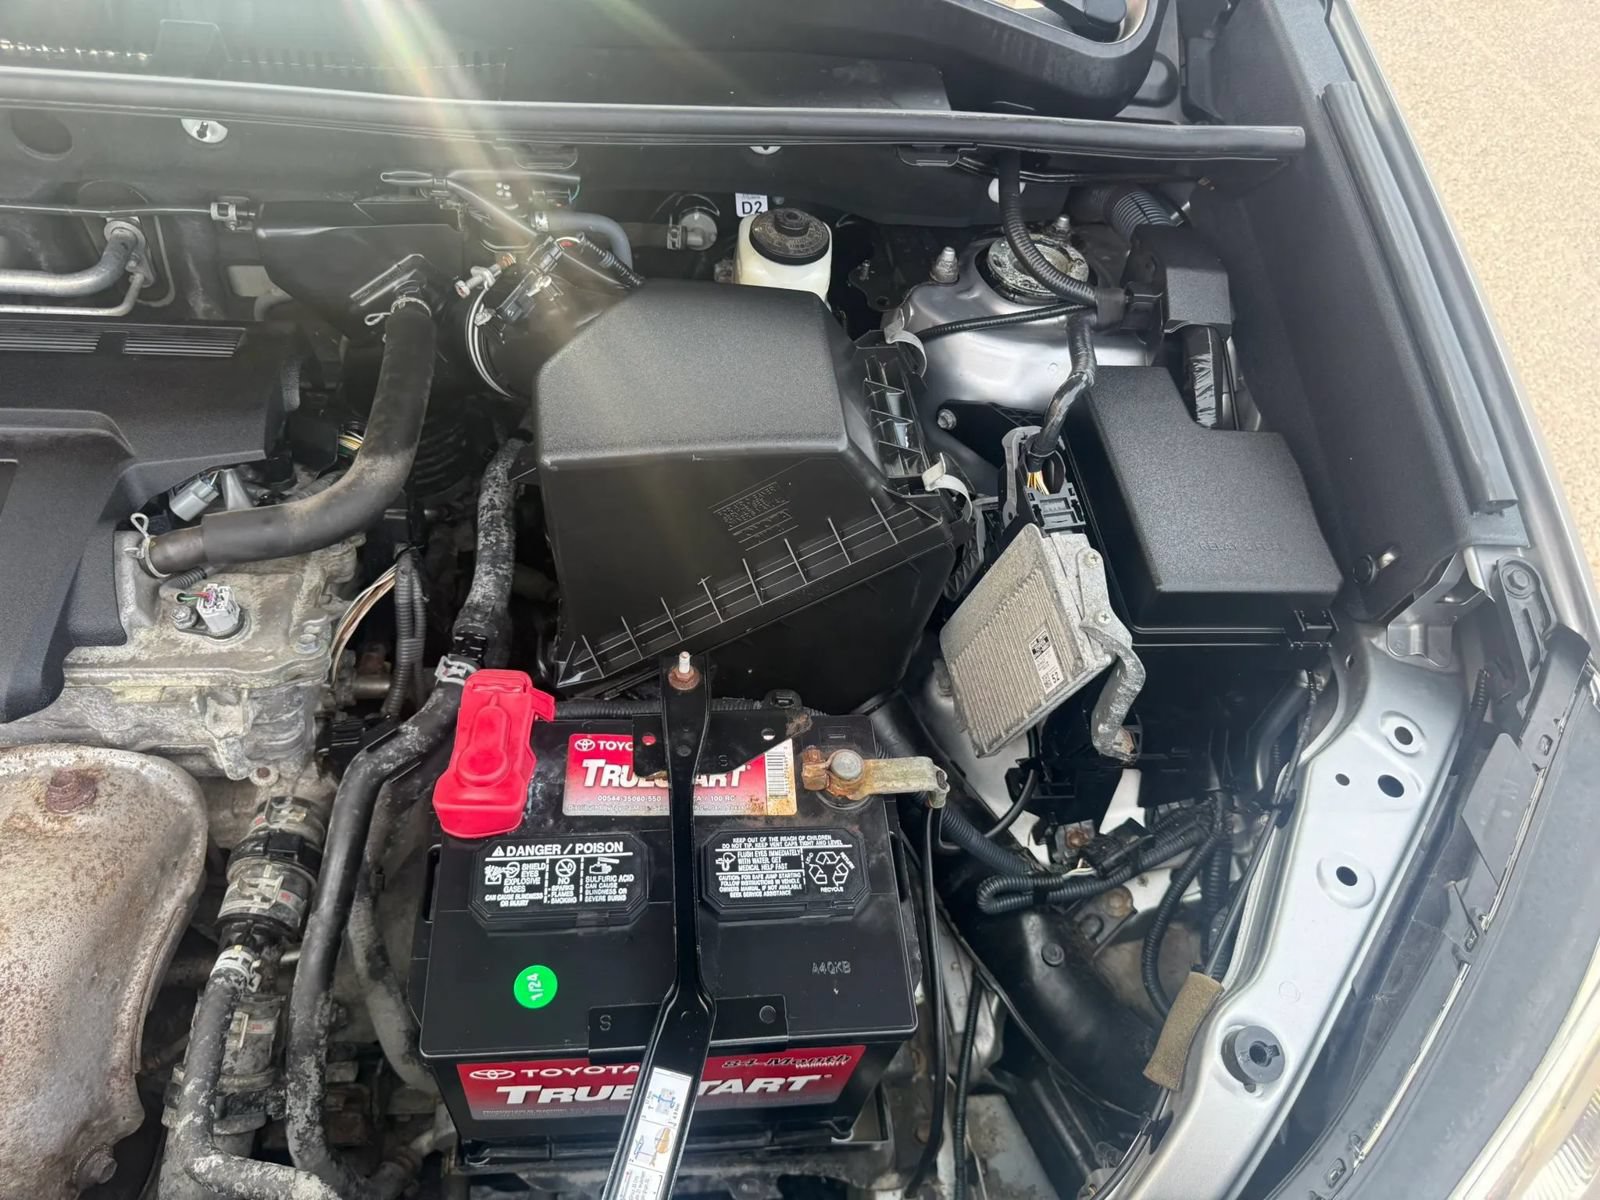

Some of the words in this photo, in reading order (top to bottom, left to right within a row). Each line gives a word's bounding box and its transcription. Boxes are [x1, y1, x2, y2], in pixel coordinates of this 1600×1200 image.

[741, 201, 762, 215] D2
[597, 740, 634, 751] TOYO
[506, 844, 561, 857] DANGER
[575, 841, 624, 855] POISON
[768, 848, 801, 857] IMMEDIATELY
[771, 856, 782, 864] GET
[521, 862, 546, 871] SHIELD
[738, 864, 760, 872] MEDICAL
[760, 863, 774, 871] HELP
[521, 870, 540, 878] EYES
[585, 875, 617, 883] SULFURIC
[618, 874, 634, 883] ACID
[503, 877, 541, 886] EXPLOSIVE
[557, 877, 570, 885] NO
[503, 885, 526, 894] GASES
[584, 888, 617, 896] BLINDNESS
[584, 895, 607, 903] SEVERE
[599, 1014, 612, 1031] S
[520, 1065, 640, 1078] TOYOTA
